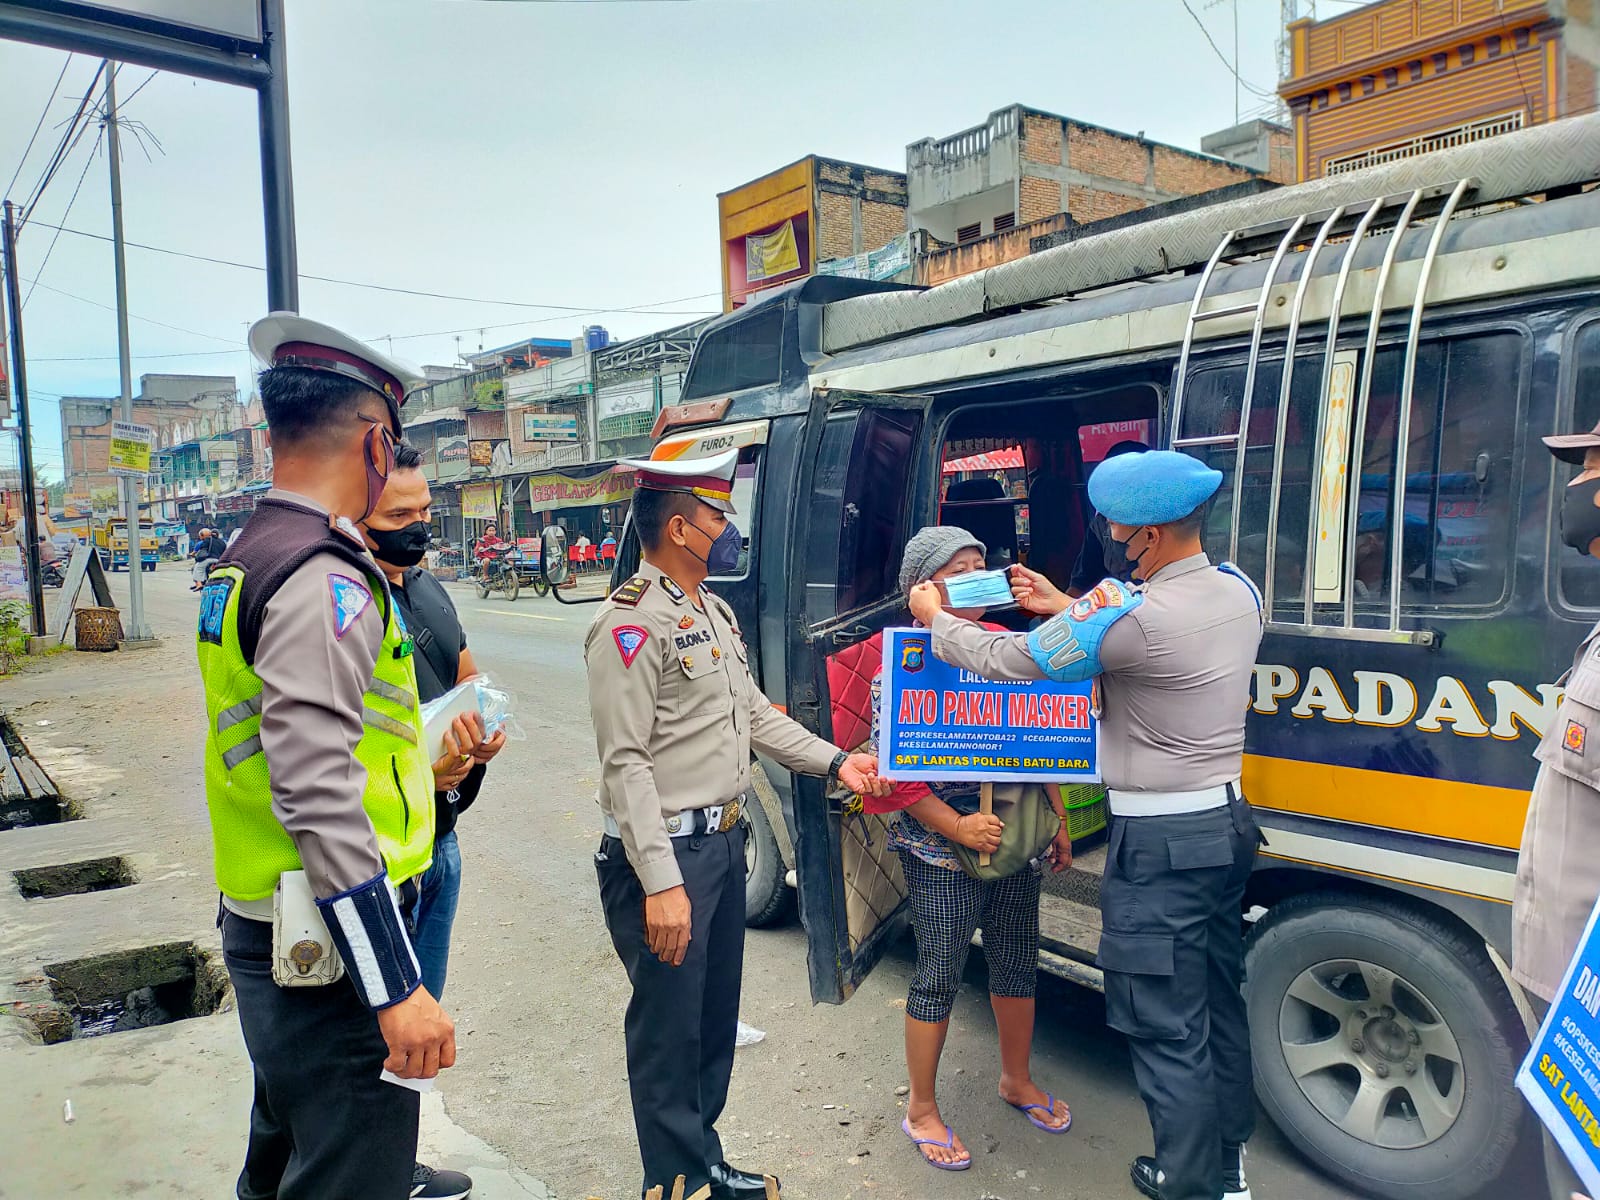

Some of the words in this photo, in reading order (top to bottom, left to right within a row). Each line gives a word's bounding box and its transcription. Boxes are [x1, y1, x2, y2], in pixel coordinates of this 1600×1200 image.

[532, 482, 599, 502] GEMILANG
[898, 689, 937, 725] AYO
[942, 690, 1001, 727] PAKAI
[1008, 692, 1090, 729] MASKER
[899, 731, 1016, 742] #OPSKESELAMATANTOBA22
[1023, 735, 1091, 743] #CEGAHCORONA
[899, 741, 1002, 751] #KESELAMATANNOMOR1
[896, 755, 919, 765] SAT
[923, 755, 969, 766] LANTAS
[973, 756, 1020, 767] POLRES
[1023, 758, 1054, 768] BATU
[1058, 759, 1089, 769] BARA
[1539, 1053, 1565, 1088] SAT
